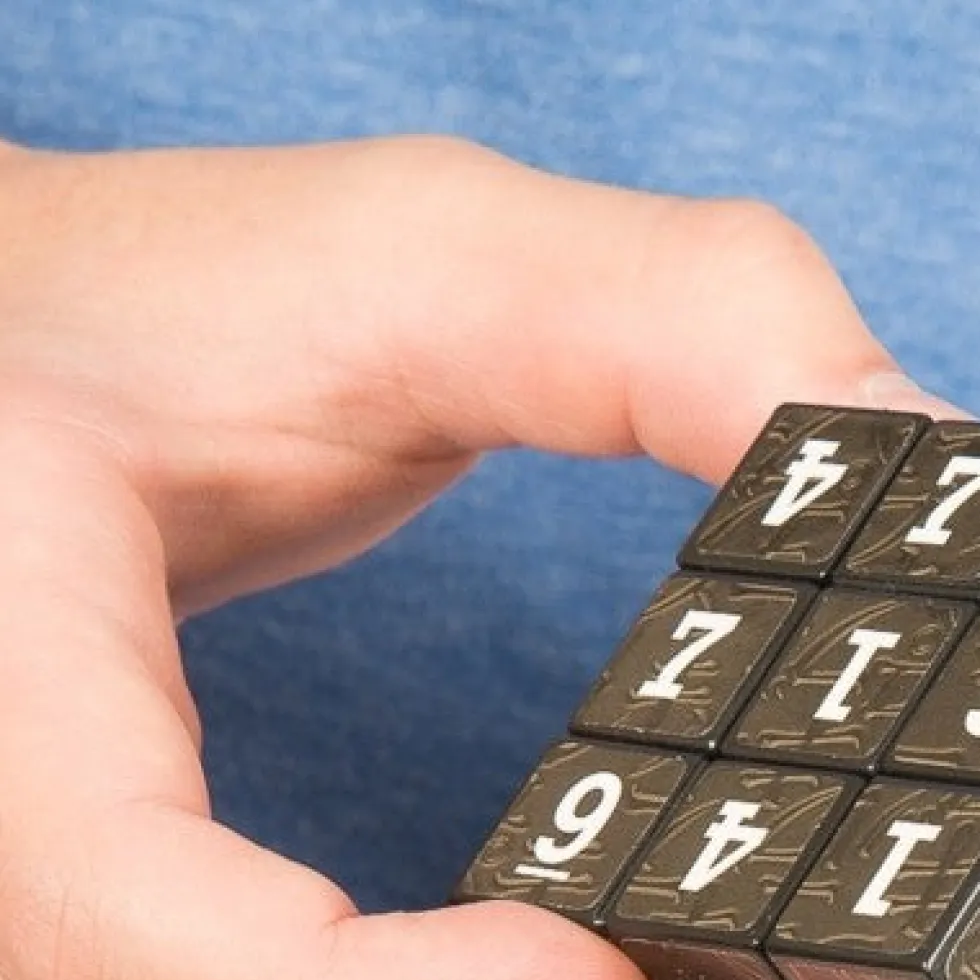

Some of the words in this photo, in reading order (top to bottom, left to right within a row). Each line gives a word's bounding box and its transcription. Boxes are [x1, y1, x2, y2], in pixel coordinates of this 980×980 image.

[760, 438, 848, 527] 4
[637, 609, 742, 700] 7
[813, 628, 902, 723] 1
[677, 800, 770, 893] 4
[851, 819, 943, 917] 1
